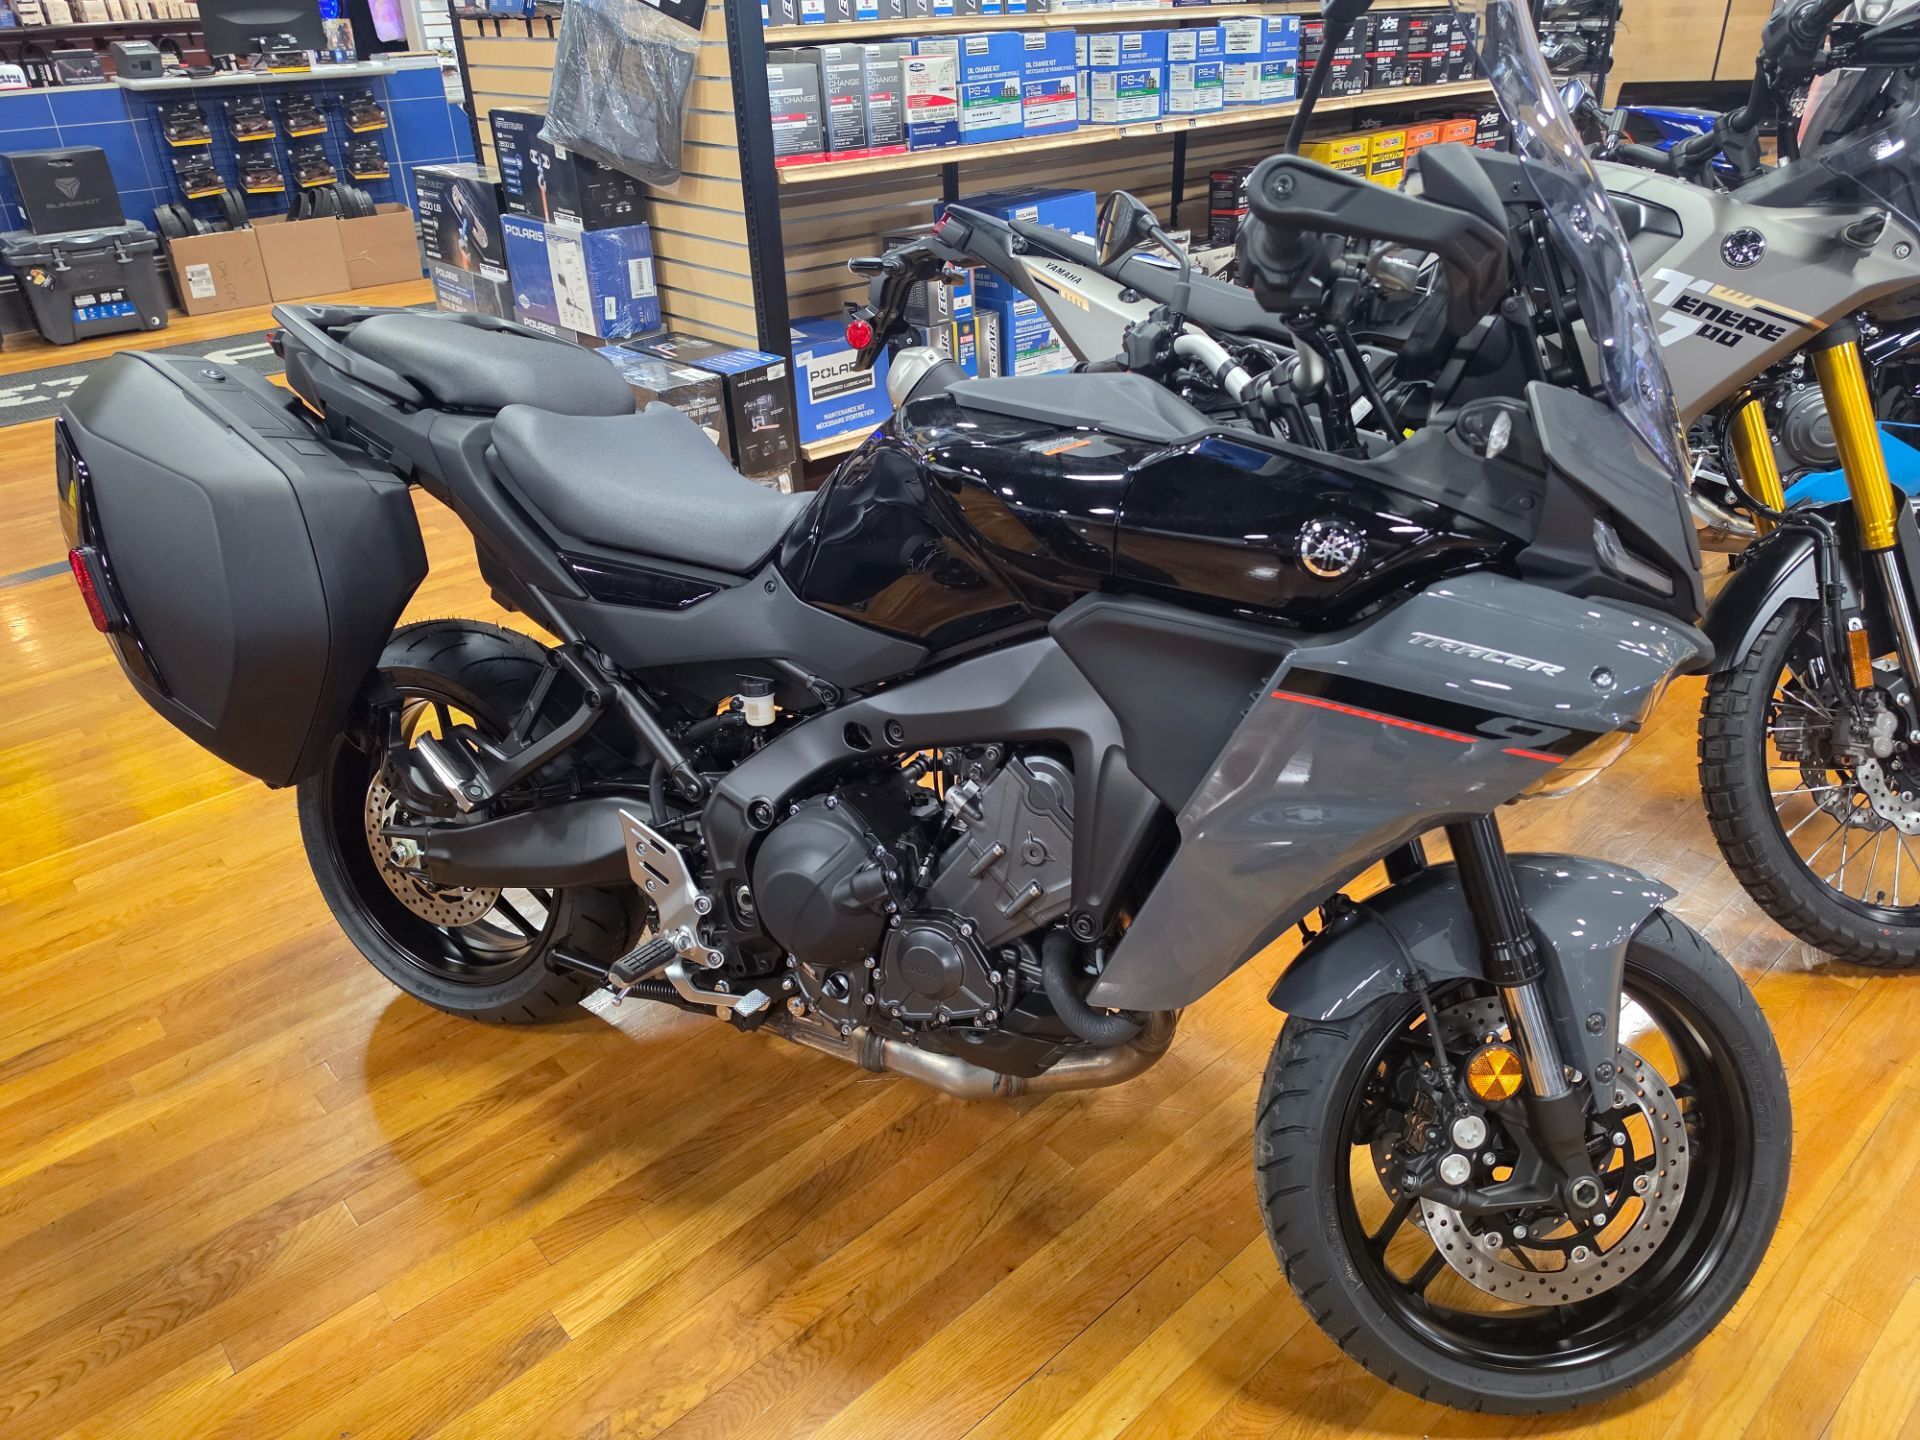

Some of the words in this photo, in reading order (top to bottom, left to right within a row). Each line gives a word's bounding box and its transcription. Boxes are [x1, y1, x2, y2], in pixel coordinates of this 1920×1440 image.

[1380, 16, 1399, 30] XPS
[1434, 23, 1449, 33] XPS
[1198, 67, 1215, 76] PS-4
[1265, 64, 1279, 72] PS-4
[828, 78, 860, 87] CHANGE
[868, 75, 899, 84] CHANGE
[1120, 74, 1145, 85] PS-4
[828, 86, 841, 94] KIT
[969, 85, 990, 96] PS-4
[784, 95, 816, 104] CHANGE
[770, 104, 782, 112] KIT
[1478, 112, 1500, 125] XPS
[554, 212, 573, 223] POLARIS
[505, 224, 544, 242] POLARIS
[480, 264, 498, 274] POLARIS
[1045, 262, 1082, 284] YAMAHA
[435, 267, 459, 283] POLARIS
[523, 317, 556, 335] POLARIS
[824, 405, 857, 420] MAINTENANCE
[856, 402, 865, 412] KIT
[1408, 631, 1567, 677] TRACER
